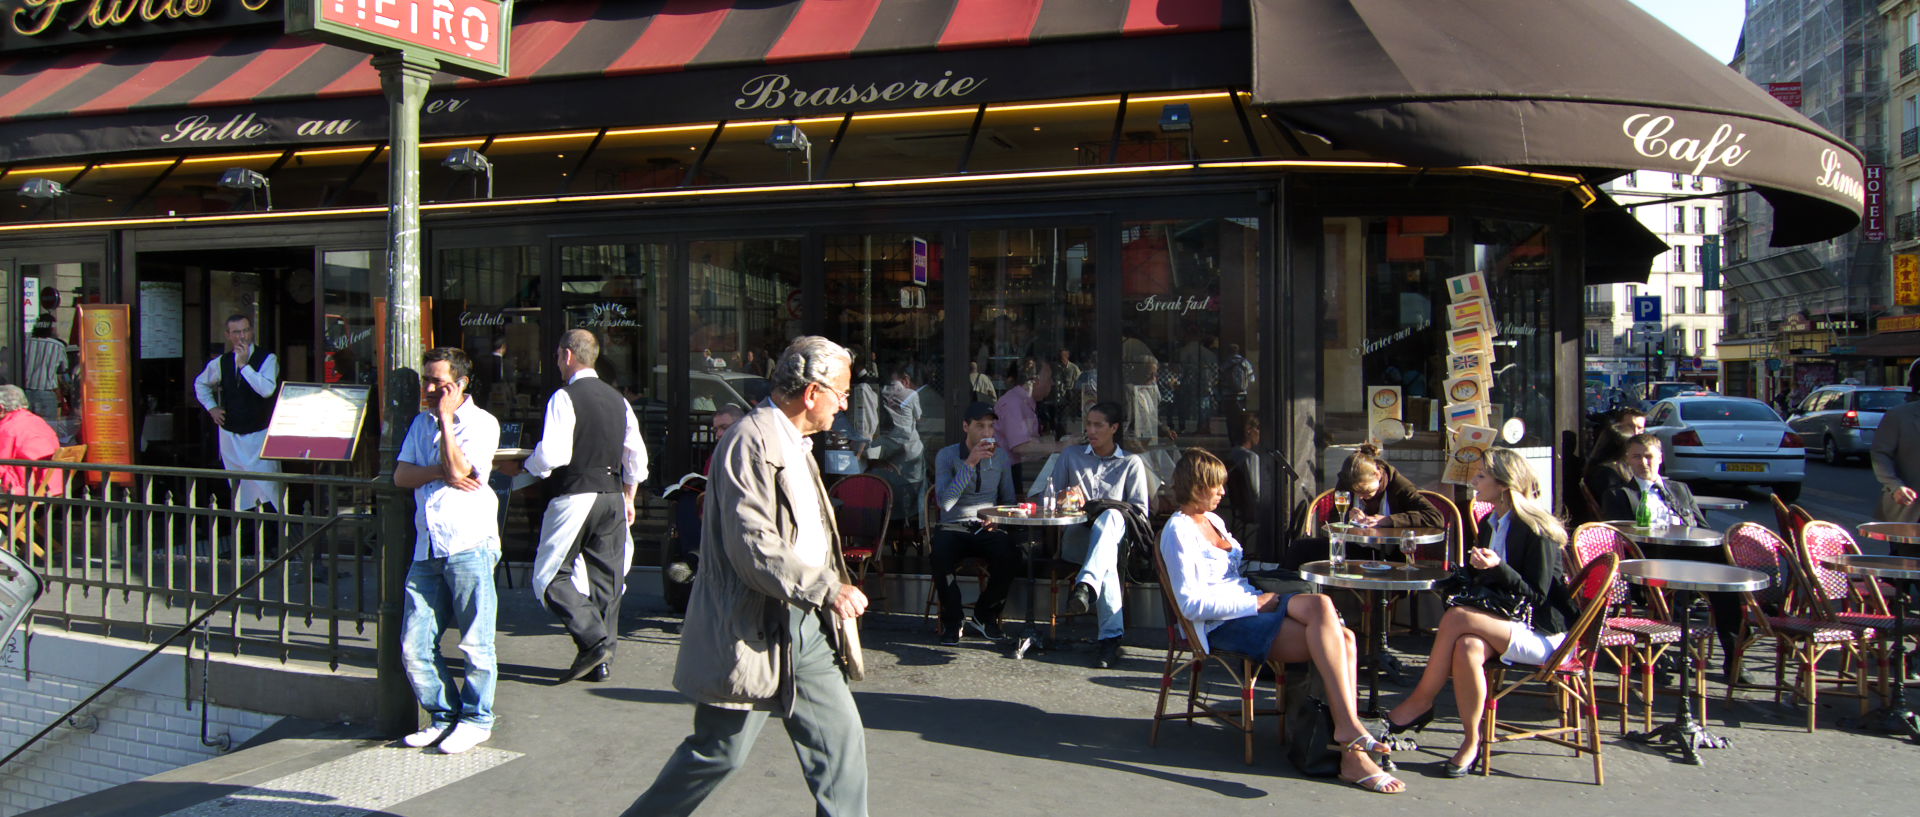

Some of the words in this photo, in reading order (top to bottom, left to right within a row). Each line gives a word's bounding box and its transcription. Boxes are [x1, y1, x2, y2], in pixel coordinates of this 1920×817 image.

[735, 70, 987, 111] Brasserie
[161, 112, 270, 144] Salle
[296, 118, 360, 137] au
[1623, 113, 1751, 176] Café
[1866, 168, 1881, 230] HOTEL
[458, 311, 505, 327] Cocktails
[1640, 301, 1654, 318] P
[1816, 320, 1859, 330] HOTEL
